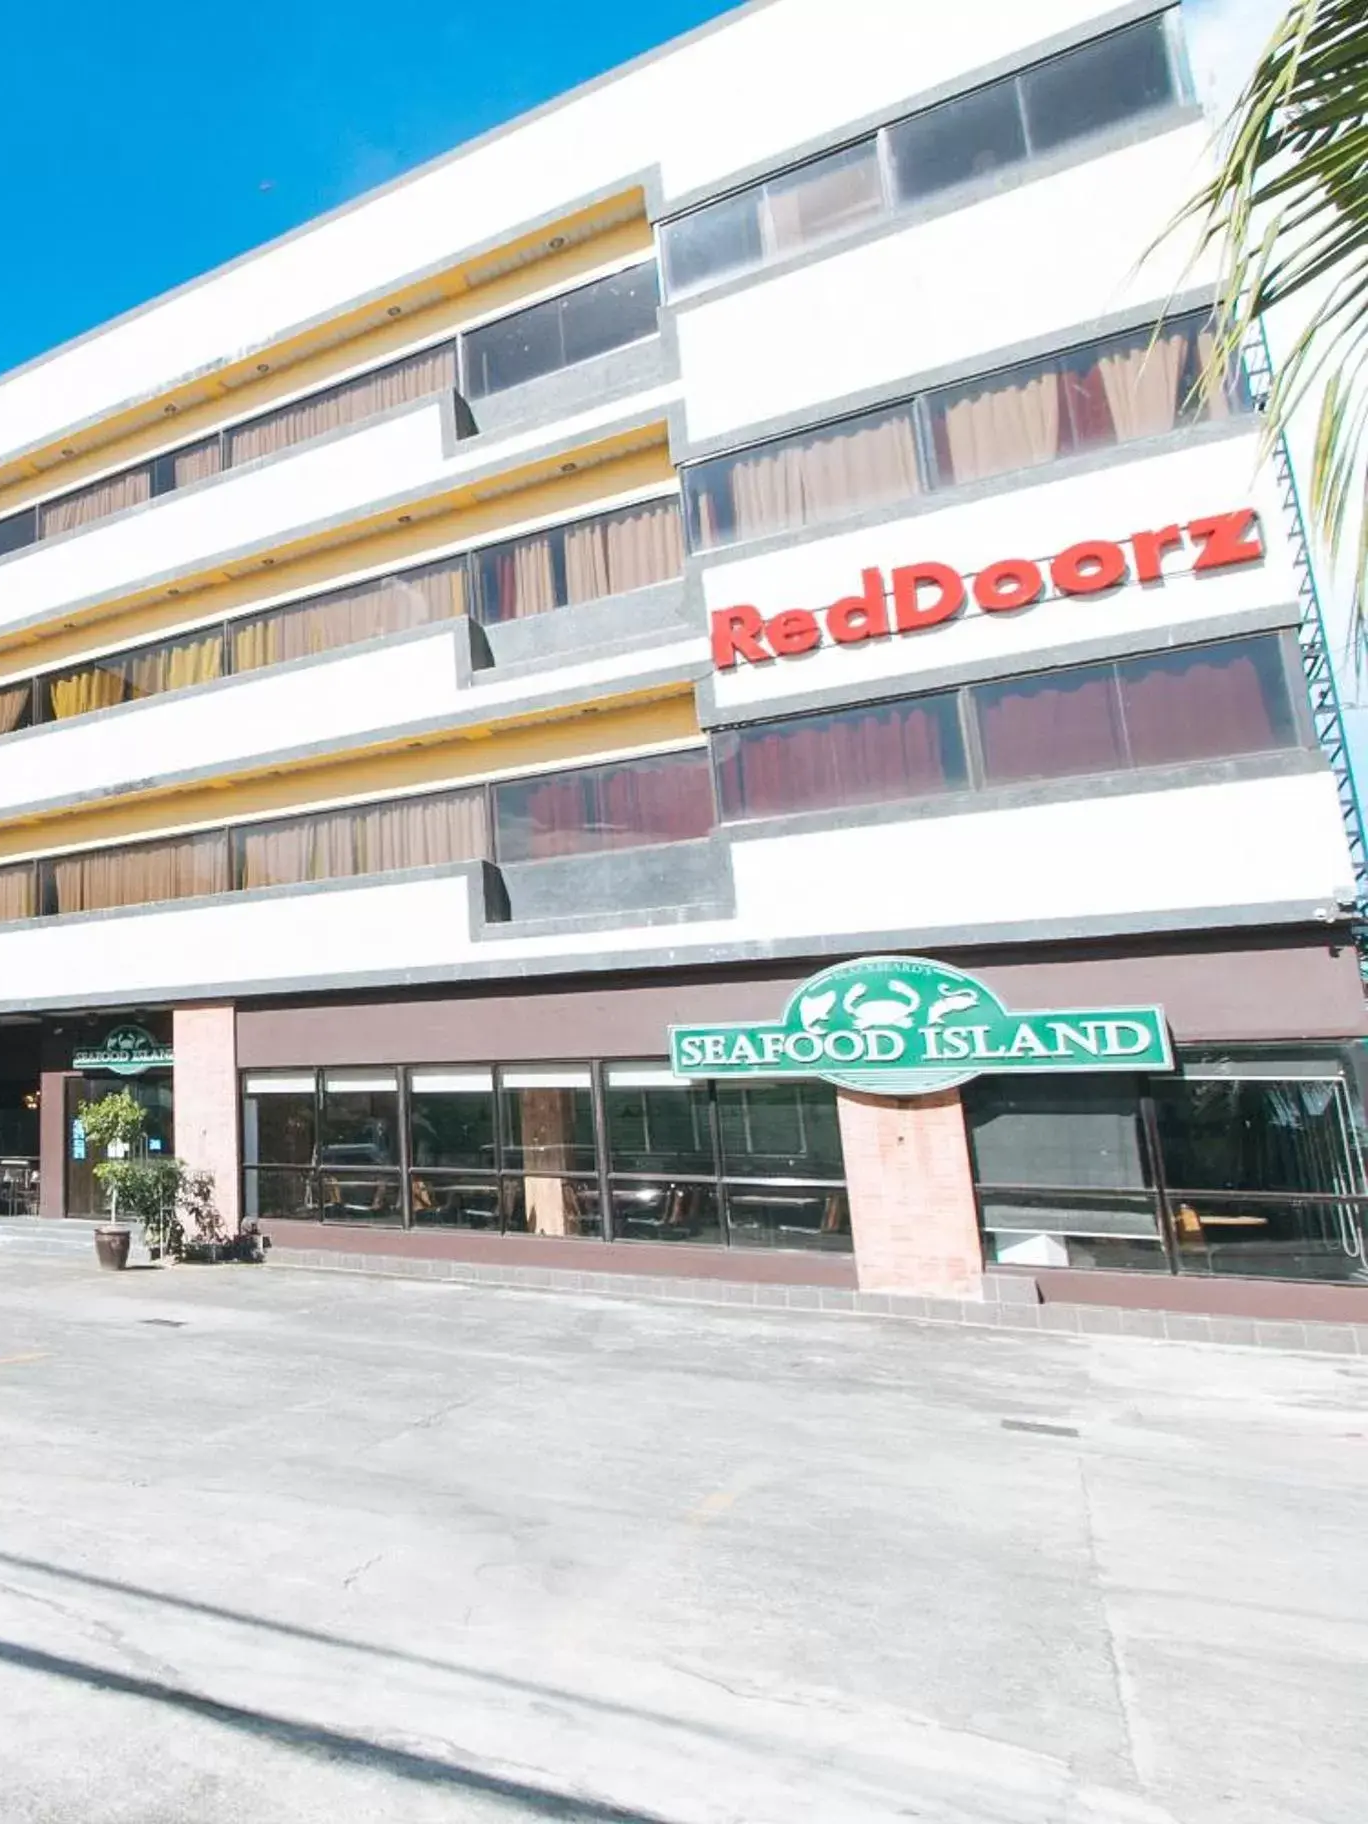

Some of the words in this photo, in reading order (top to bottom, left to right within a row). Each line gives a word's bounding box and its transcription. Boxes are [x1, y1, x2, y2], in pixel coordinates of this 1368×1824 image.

[710, 507, 1263, 669] RedDoorz
[133, 1047, 173, 1061] ISLAN
[681, 1029, 905, 1066] SEAFOOD
[918, 1021, 1152, 1060] ISLAND
